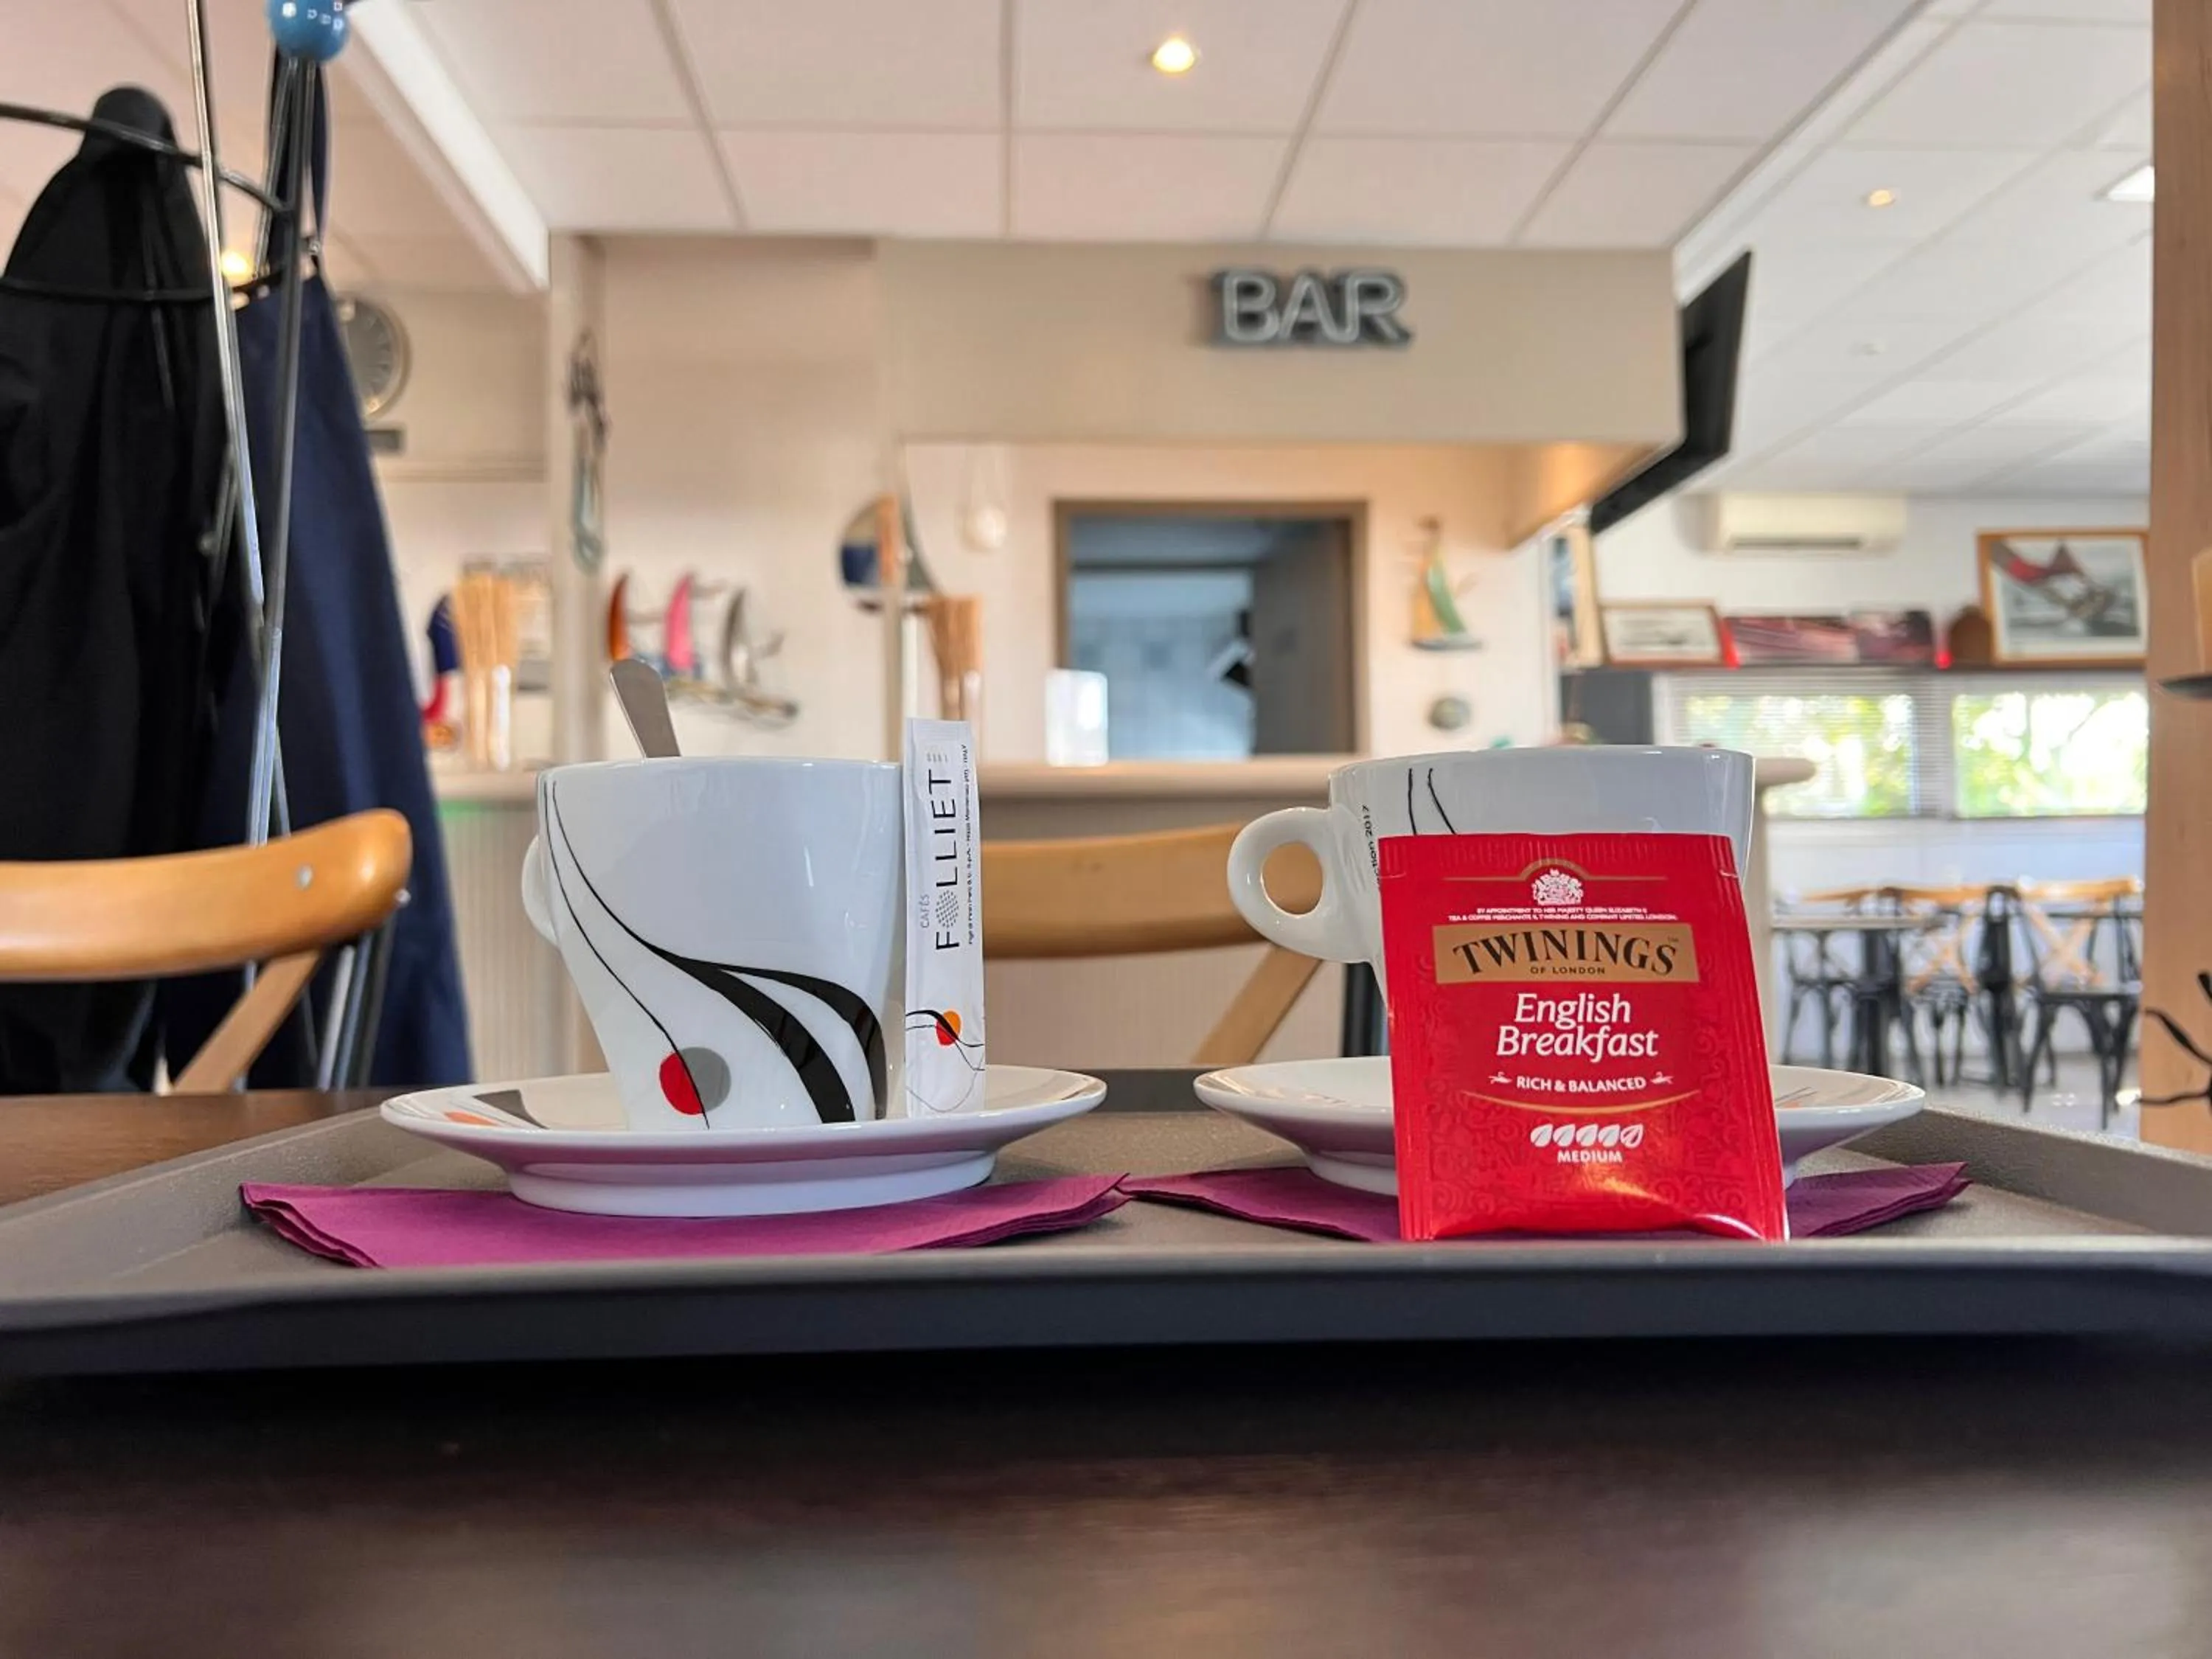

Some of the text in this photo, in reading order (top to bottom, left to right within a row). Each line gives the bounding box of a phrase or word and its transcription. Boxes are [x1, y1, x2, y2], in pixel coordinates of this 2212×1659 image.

[1219, 269, 1411, 343] BAR
[1362, 804, 1372, 837] 2017
[928, 768, 960, 950] FOLLIET
[918, 893, 930, 928] CAFÉS
[1453, 929, 1677, 975] TWININGS
[1530, 966, 1606, 975] OF LONDON
[1514, 992, 1632, 1030] English
[1496, 1024, 1659, 1062] Breakfast
[1516, 1076, 1646, 1093] RICH & BALANCED
[1557, 1150, 1623, 1163] MEDIUM
